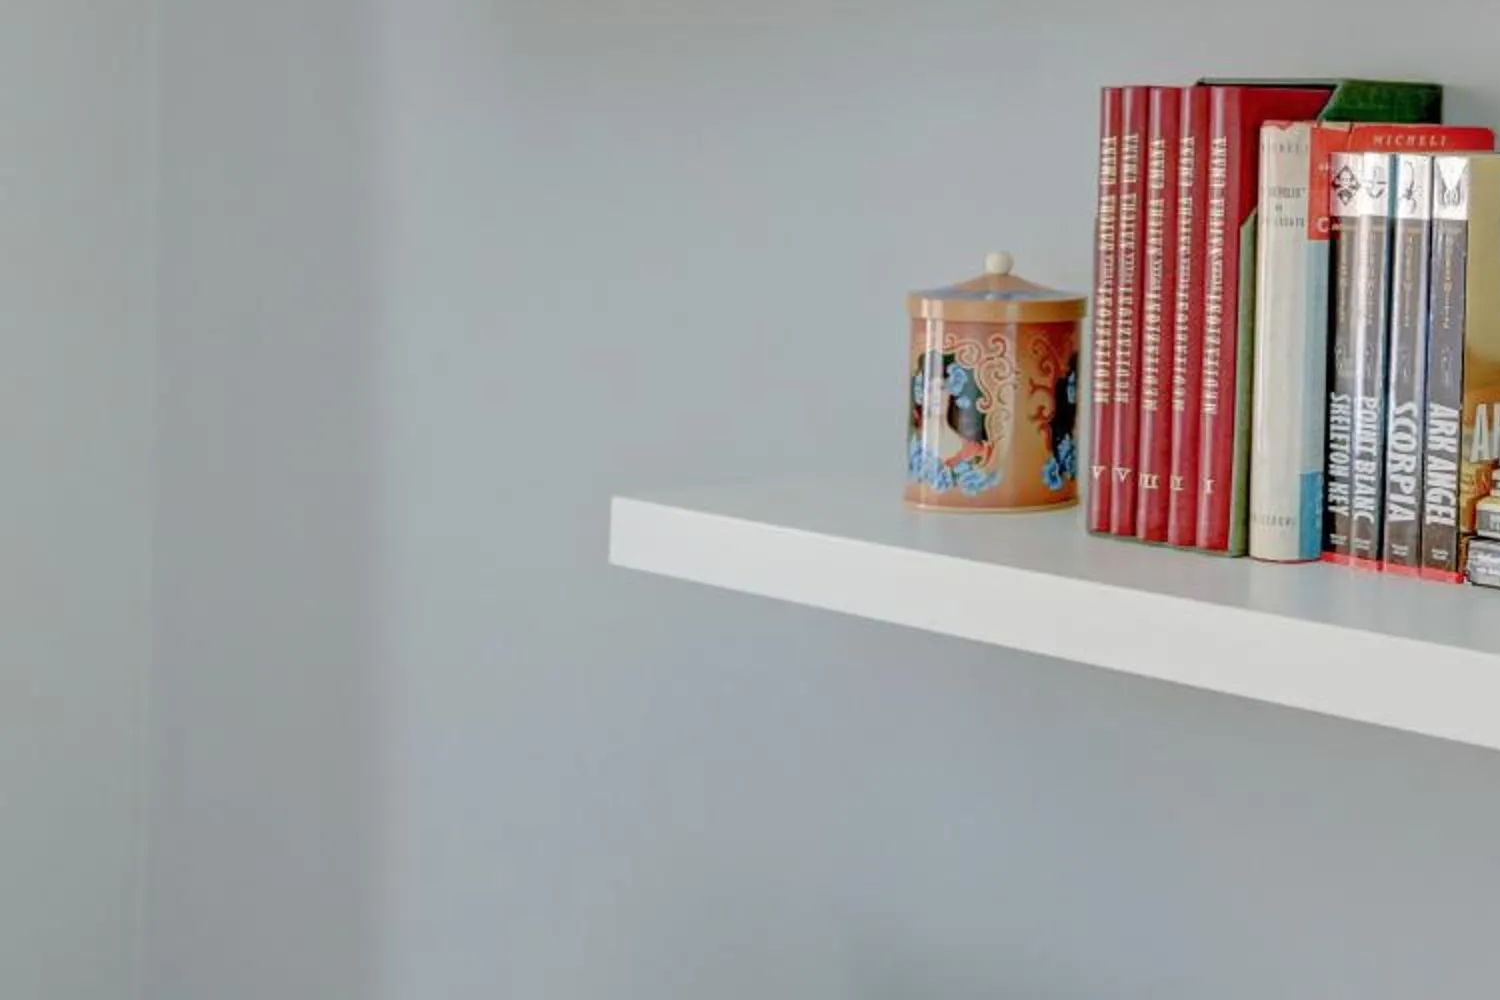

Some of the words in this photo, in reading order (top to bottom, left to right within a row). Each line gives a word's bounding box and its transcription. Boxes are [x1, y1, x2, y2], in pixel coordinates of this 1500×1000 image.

[1374, 135, 1447, 147] MICHELI
[1329, 392, 1350, 477] SKELETON
[1354, 396, 1378, 457] POINT
[1428, 402, 1458, 453] ARK
[1353, 460, 1375, 524] BLANC
[1388, 402, 1419, 523] SCORPIA
[1425, 455, 1457, 527] ANGEL
[1328, 482, 1348, 516] KEY
